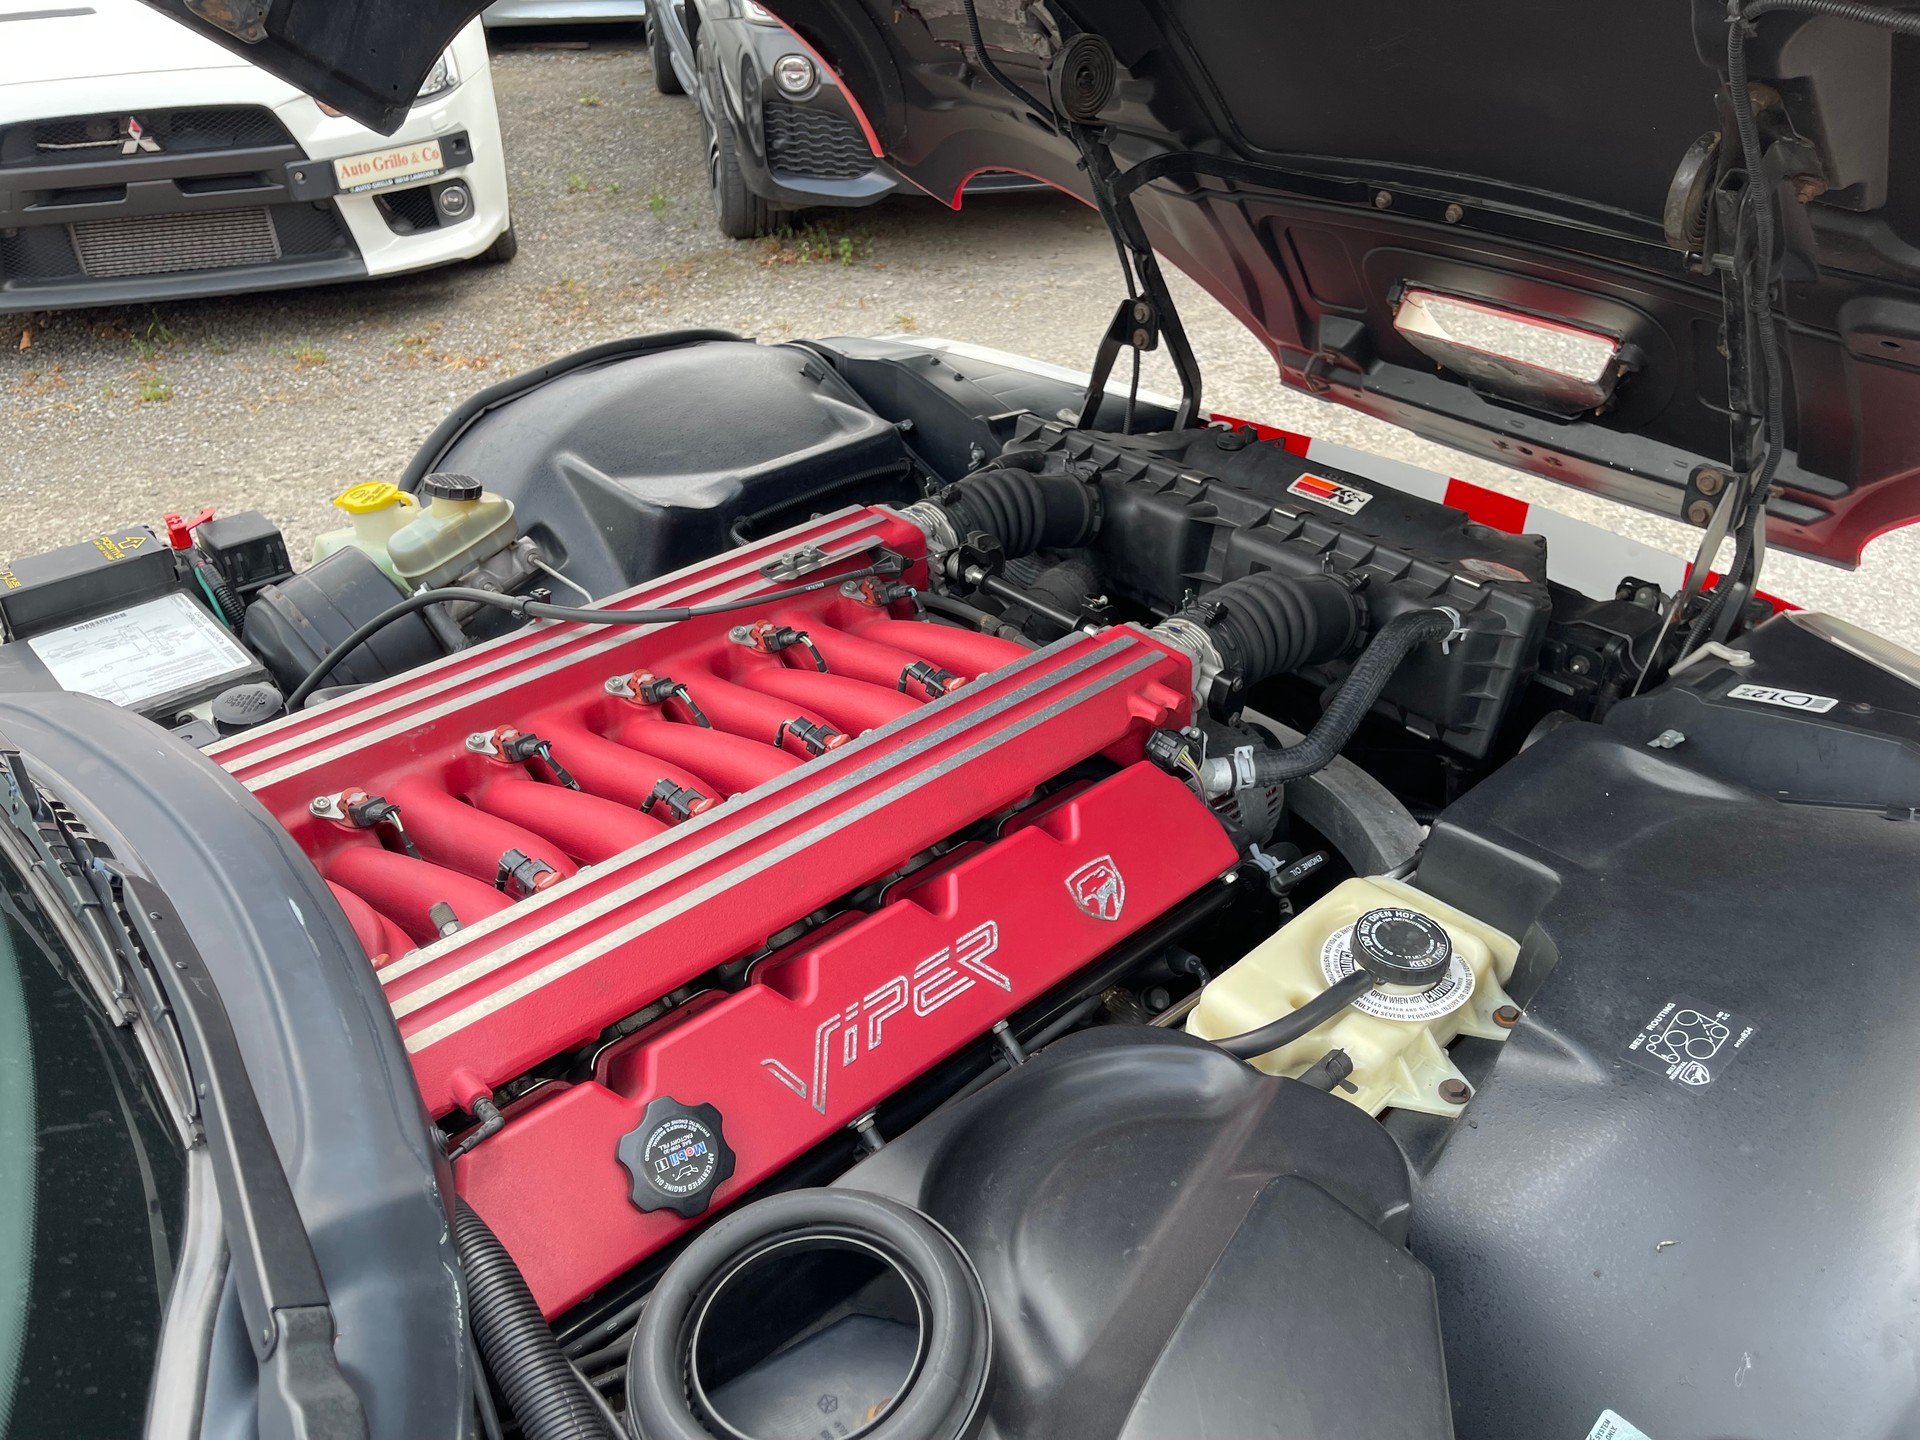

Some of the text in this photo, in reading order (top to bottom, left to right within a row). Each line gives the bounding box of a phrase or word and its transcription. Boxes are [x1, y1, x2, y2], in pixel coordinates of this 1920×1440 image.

[341, 147, 440, 179] Auto Grillo & Co
[1289, 854, 1323, 876] ENGINE OIL
[1359, 910, 1416, 947] DO NOT OPEN HOT
[1408, 959, 1433, 968] KEEP
[1431, 941, 1447, 961] TIGHT
[1322, 954, 1337, 985] INSTRUCTION
[1370, 990, 1389, 1002] OPEN
[1389, 996, 1409, 1005] WHEN
[1425, 979, 1455, 1002] CAUTION
[1354, 1000, 1372, 1011] SULT
[1380, 1010, 1407, 1020] SEVERE
[1407, 1009, 1442, 1020] PERSONAL
[1442, 1000, 1461, 1012] INJURY
[1628, 1002, 1677, 1051] BELT ROUTING
[652, 1129, 667, 1148] MANUAL
[658, 1132, 694, 1151] FACTORY FILL
[669, 1141, 707, 1167] Mobil
[654, 1152, 715, 1193] API CERTIFIED ENGINE OIL
[1594, 1418, 1612, 1440] SYSTEM
